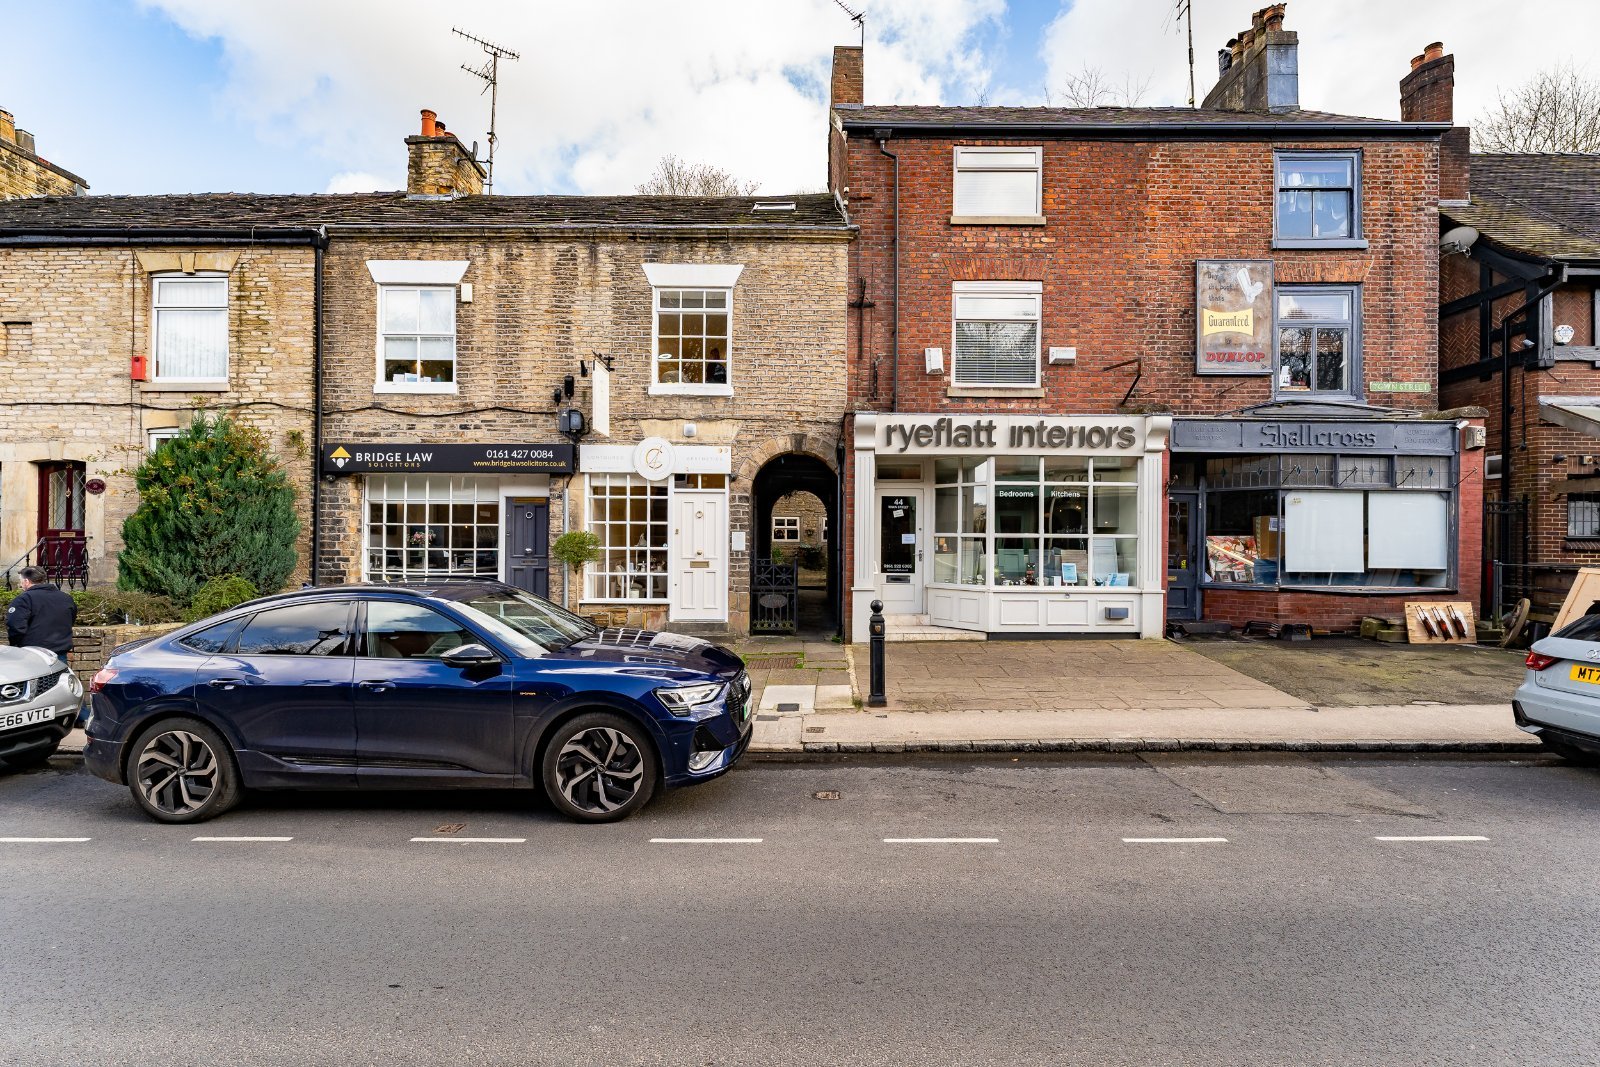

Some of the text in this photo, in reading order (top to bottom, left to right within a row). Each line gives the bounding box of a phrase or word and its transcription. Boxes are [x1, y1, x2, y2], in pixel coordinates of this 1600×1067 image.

[1206, 351, 1265, 363] DUNLOP
[1400, 383, 1429, 391] STREET
[886, 417, 1136, 452] ryeflatt interiors
[1260, 422, 1377, 447] Shallcross
[355, 452, 433, 462] BRIDGE LAW
[486, 449, 554, 459] 0161 427 0084
[473, 460, 567, 468] www.bridgelawsolicitors.co.uk
[999, 490, 1034, 498] Bedrooms
[1050, 490, 1081, 498] Kitchens
[27, 708, 50, 722] VTC
